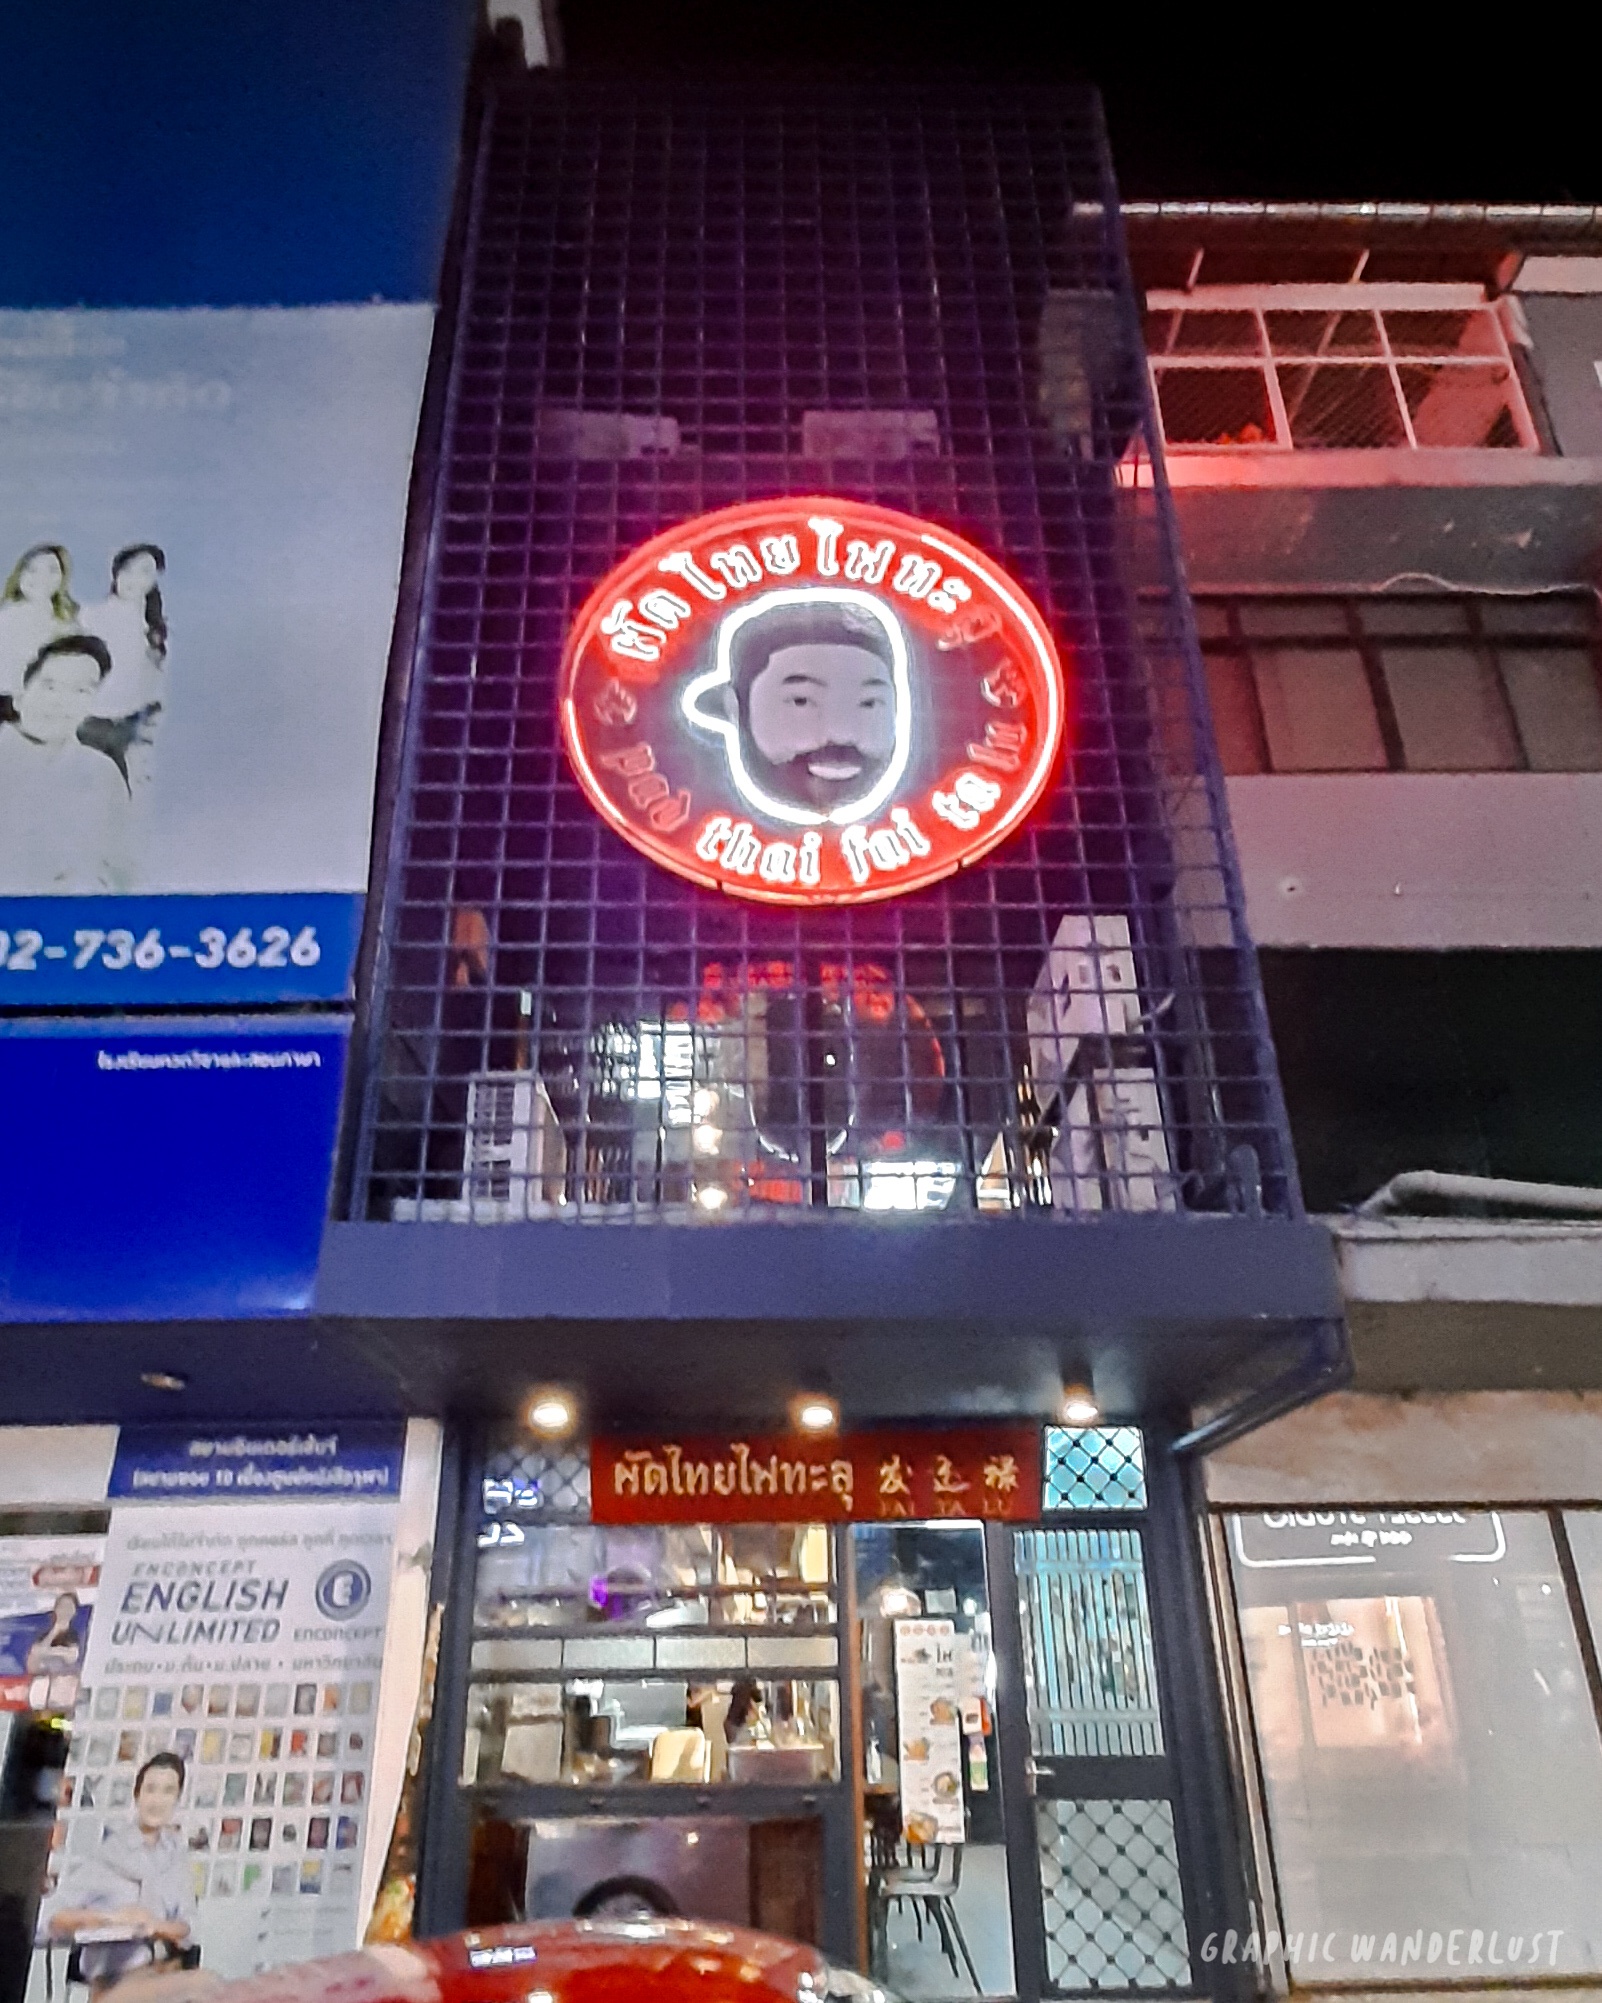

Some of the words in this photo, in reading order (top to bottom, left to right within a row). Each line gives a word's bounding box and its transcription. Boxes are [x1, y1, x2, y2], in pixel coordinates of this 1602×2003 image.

[601, 742, 691, 833] pad
[696, 816, 822, 884] thai
[841, 807, 931, 883] fai
[931, 770, 1002, 831] ta
[614, 1442, 854, 1513] ผัดไทยไฟทะลุ
[133, 1559, 257, 1577] ENCONCEPT
[120, 1577, 289, 1614] ENGLISH
[111, 1618, 280, 1645] UNLIMITED
